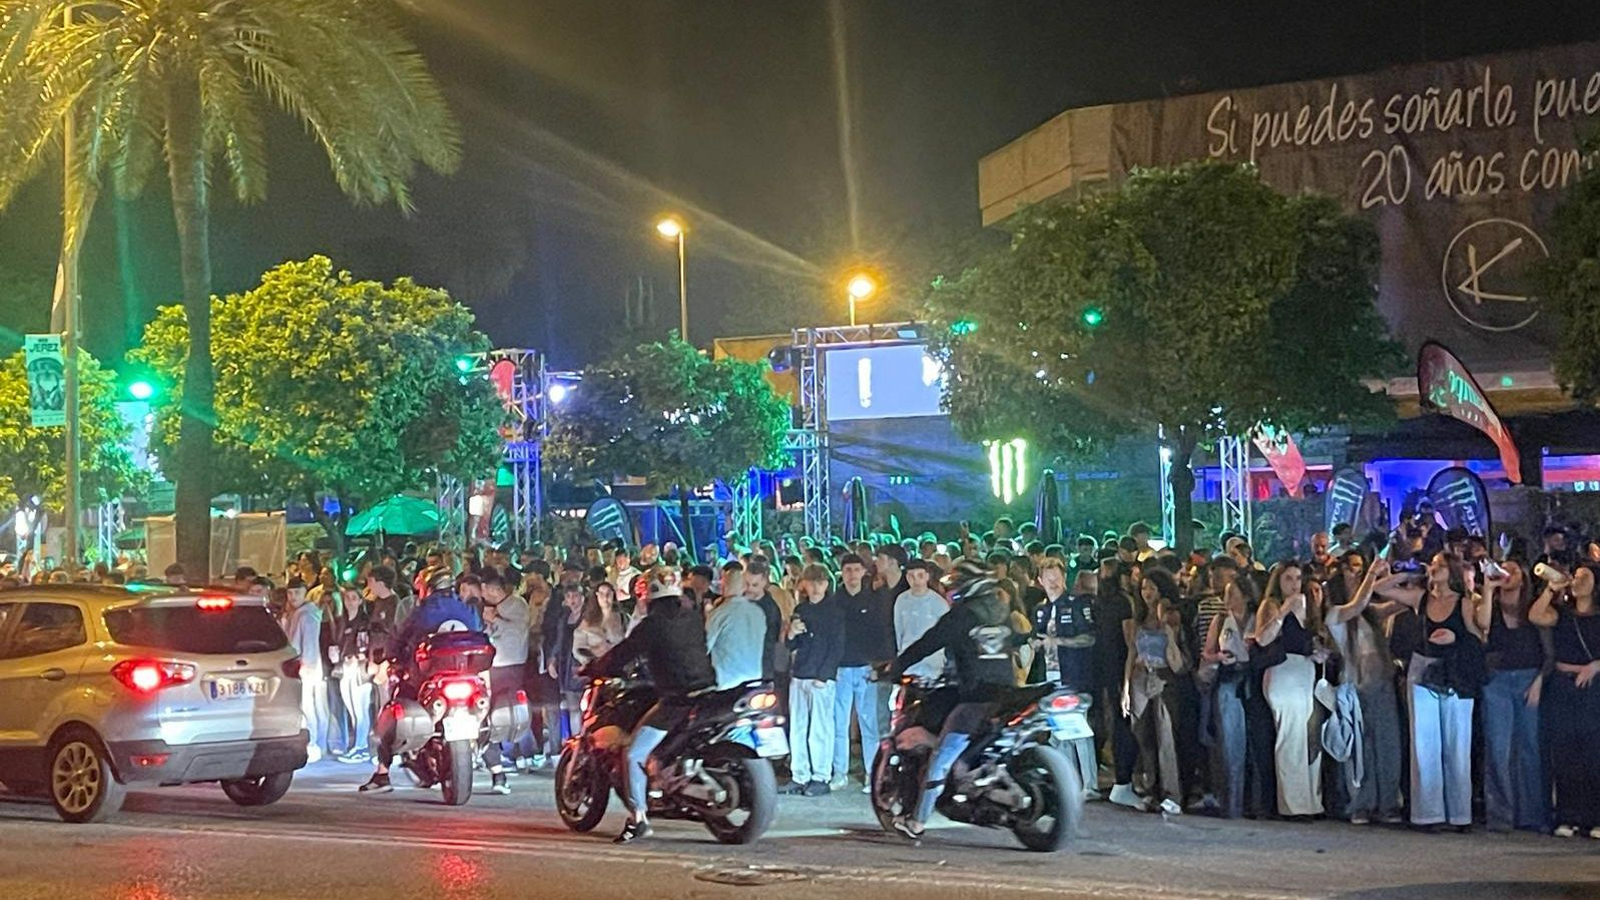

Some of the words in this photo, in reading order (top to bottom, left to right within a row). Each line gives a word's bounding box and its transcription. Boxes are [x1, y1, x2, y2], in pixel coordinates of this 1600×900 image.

[1206, 96, 1238, 157] Si
[1251, 83, 1375, 164] puedes
[1384, 66, 1516, 134] soñarlo,
[1361, 145, 1411, 209] 20
[1425, 151, 1504, 200] años
[1520, 148, 1590, 191] con
[29, 343, 59, 353] JEREZ
[219, 682, 246, 696] 3186
